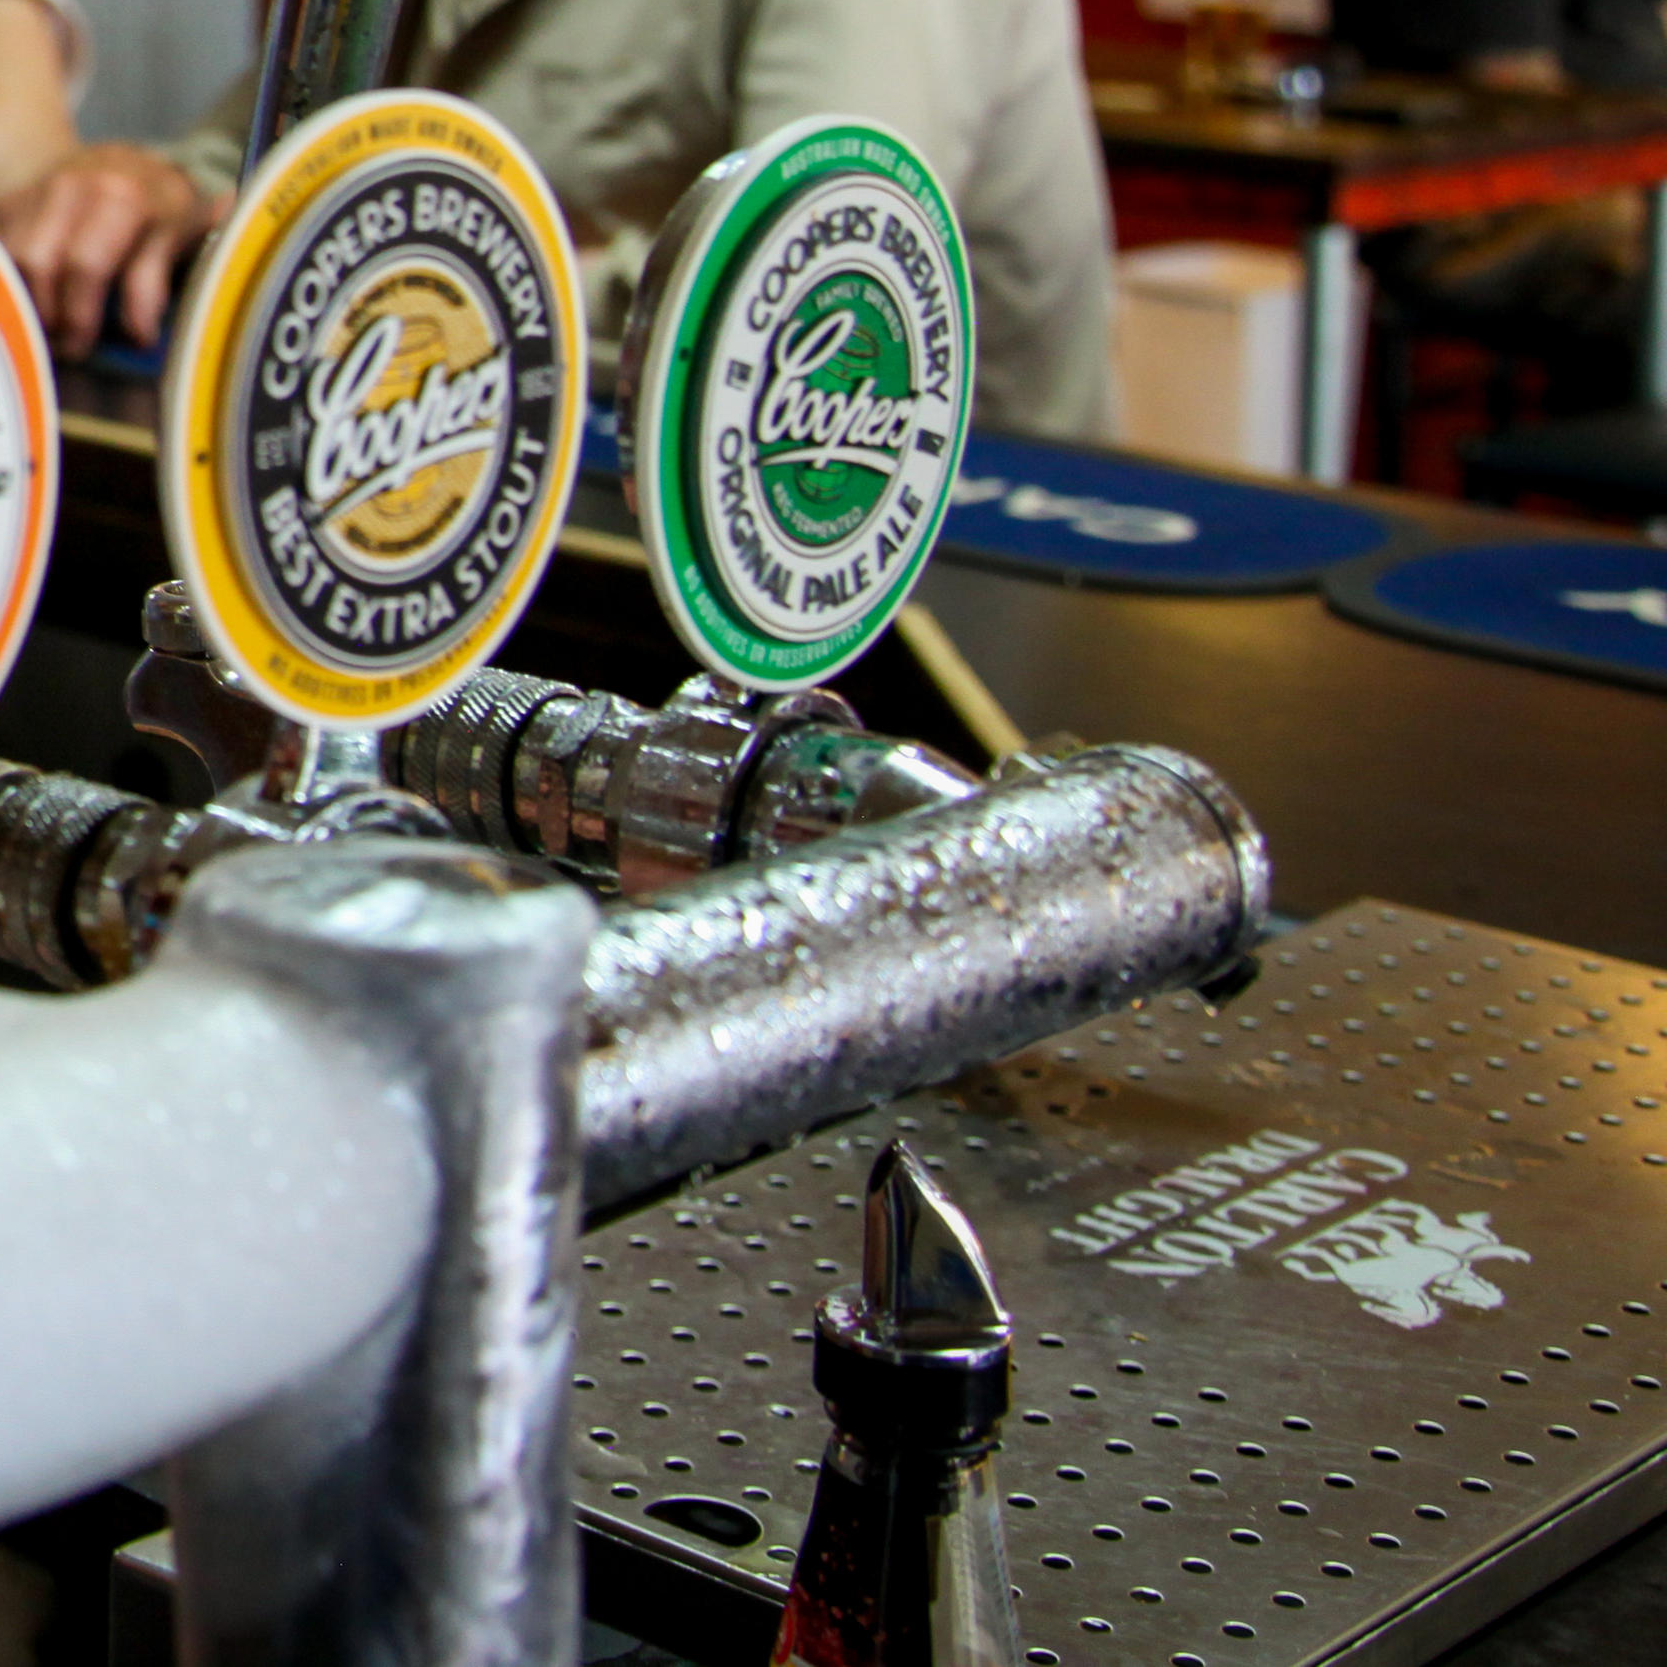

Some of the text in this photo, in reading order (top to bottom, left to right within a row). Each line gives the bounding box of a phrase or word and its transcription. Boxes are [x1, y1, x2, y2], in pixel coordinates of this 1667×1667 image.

[262, 183, 547, 400] COOPERS BREWERY
[747, 206, 951, 402] COOPERS BREWERY
[758, 309, 915, 462] Coopers
[306, 315, 513, 508] Coopers
[261, 485, 335, 607] BEST
[324, 580, 456, 644] EXTRA
[454, 427, 545, 602] STOUT
[717, 427, 792, 610] ORIGINAL
[801, 552, 872, 613] PALE
[876, 483, 924, 573] ALE
[1048, 1128, 1324, 1256] DRAUGHT
[1106, 1147, 1409, 1291] CARLTON
